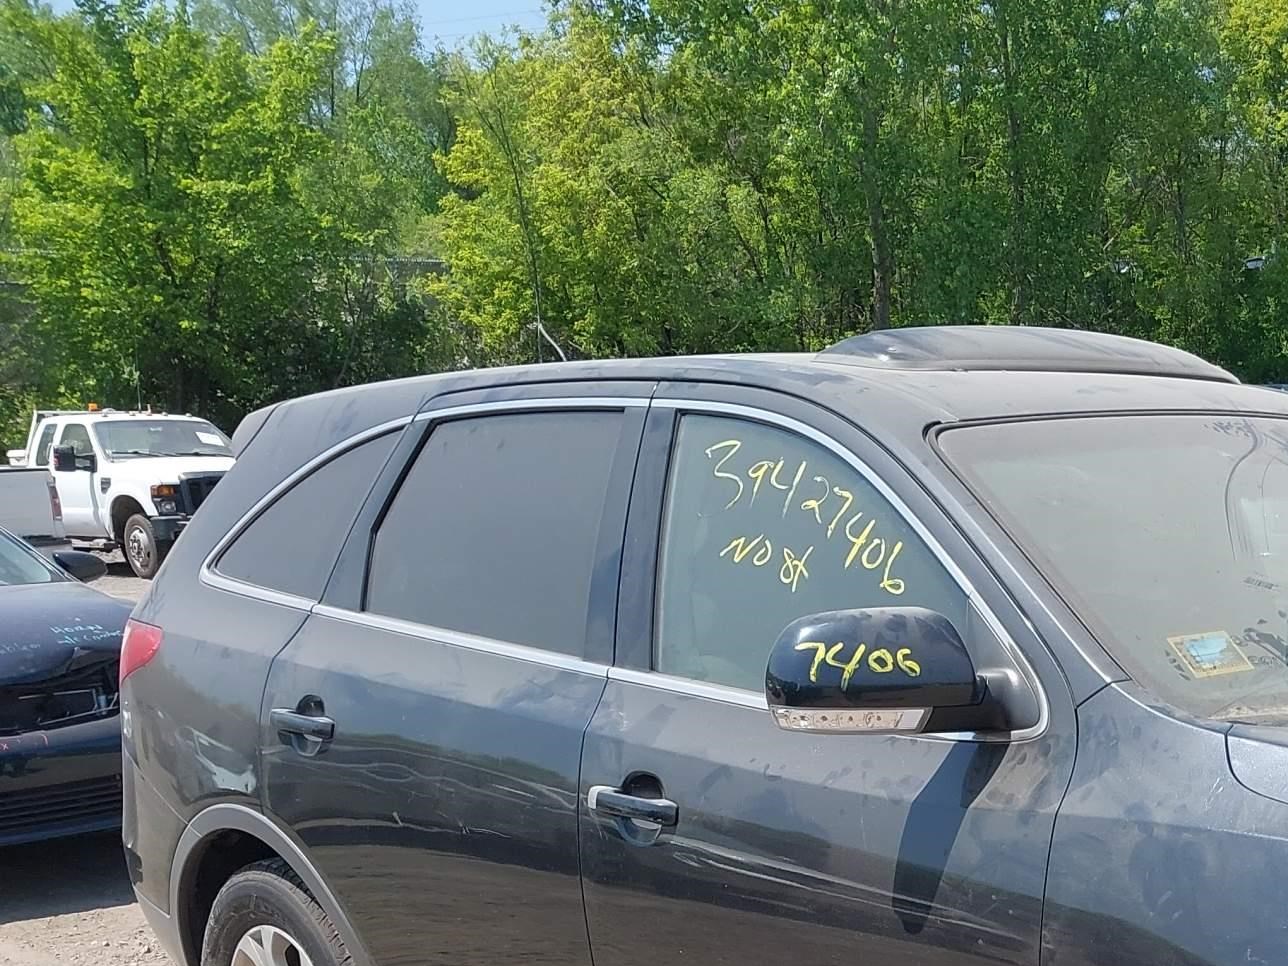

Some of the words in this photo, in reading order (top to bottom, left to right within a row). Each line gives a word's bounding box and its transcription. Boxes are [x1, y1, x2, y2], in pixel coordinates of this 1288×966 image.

[705, 440, 905, 594] 39427406
[719, 533, 772, 566] NO
[795, 642, 921, 690] 7406
